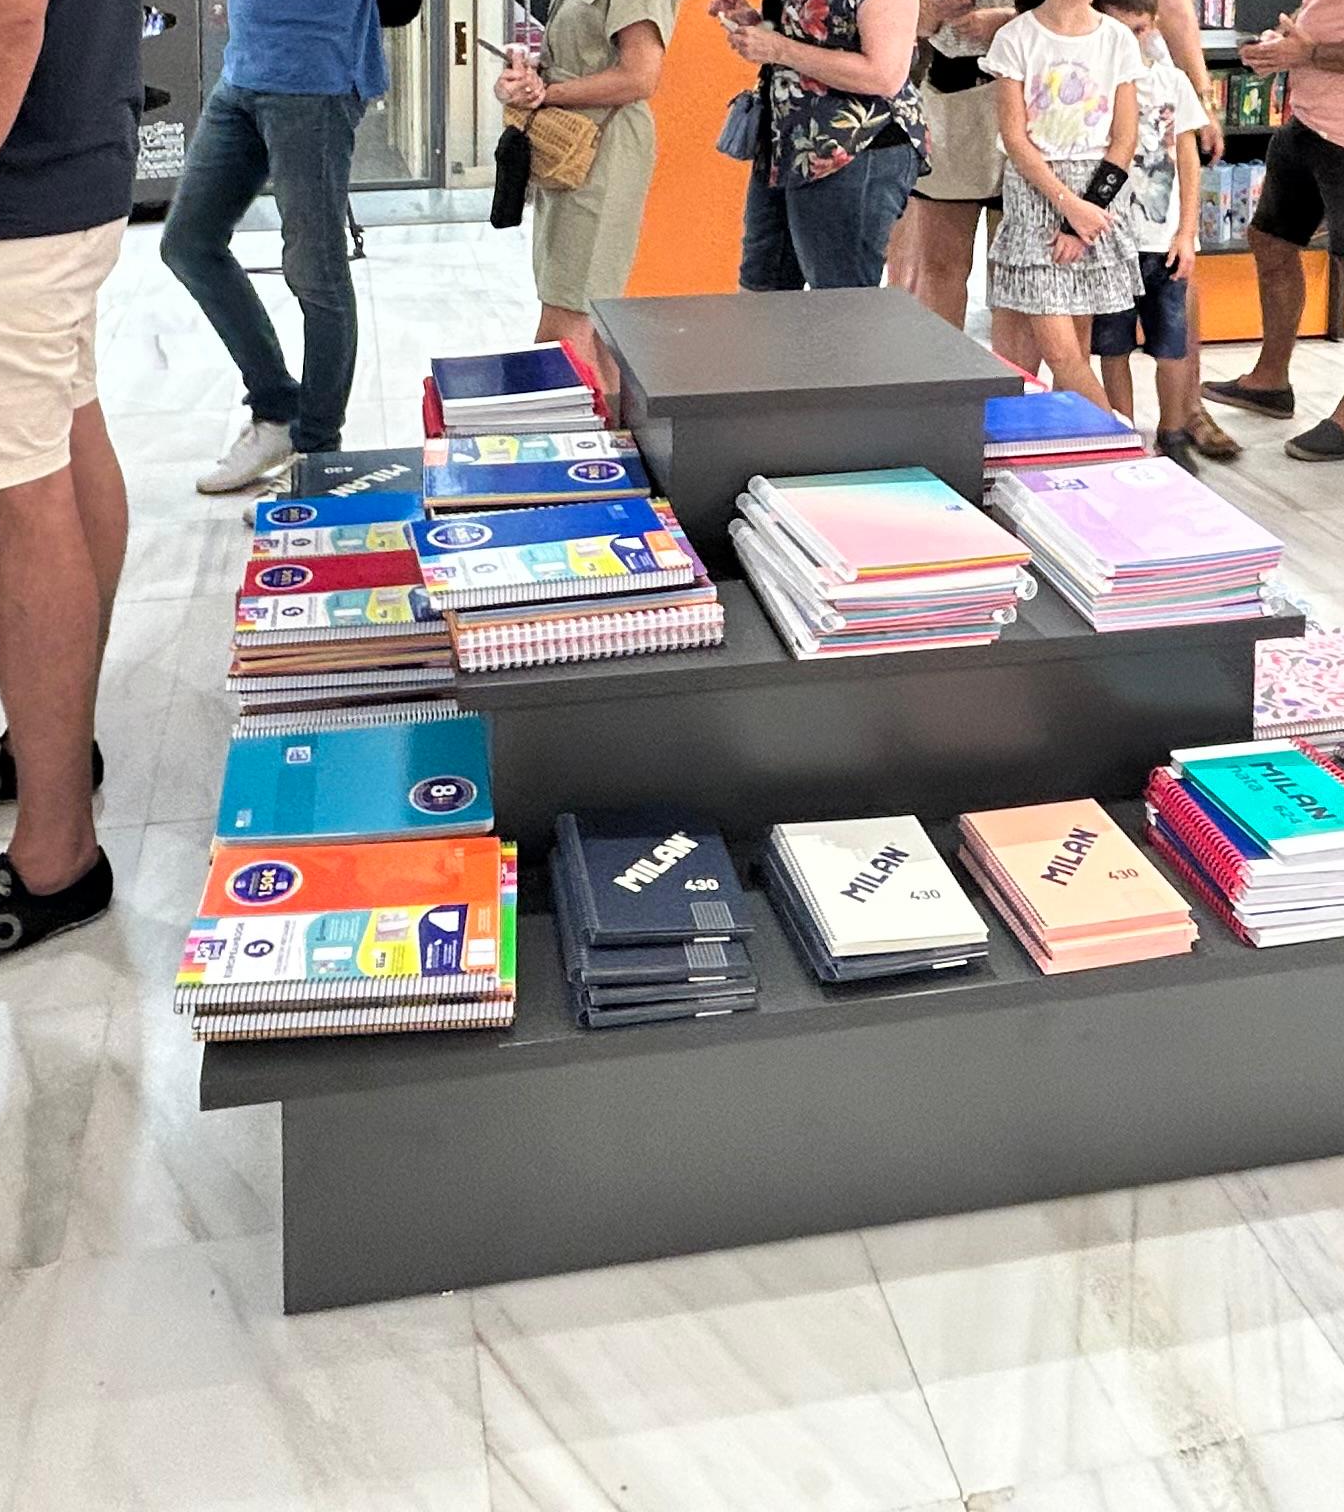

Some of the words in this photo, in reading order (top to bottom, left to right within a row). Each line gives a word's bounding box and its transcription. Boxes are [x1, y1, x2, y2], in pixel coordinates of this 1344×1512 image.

[1248, 761, 1337, 820] MILAN
[1272, 804, 1303, 825] 624
[613, 831, 699, 893] MILAN
[839, 844, 910, 903] MILAN
[1040, 826, 1099, 886] MILAN
[1108, 868, 1138, 883] 430
[684, 877, 719, 892] 430
[910, 888, 941, 902] 430
